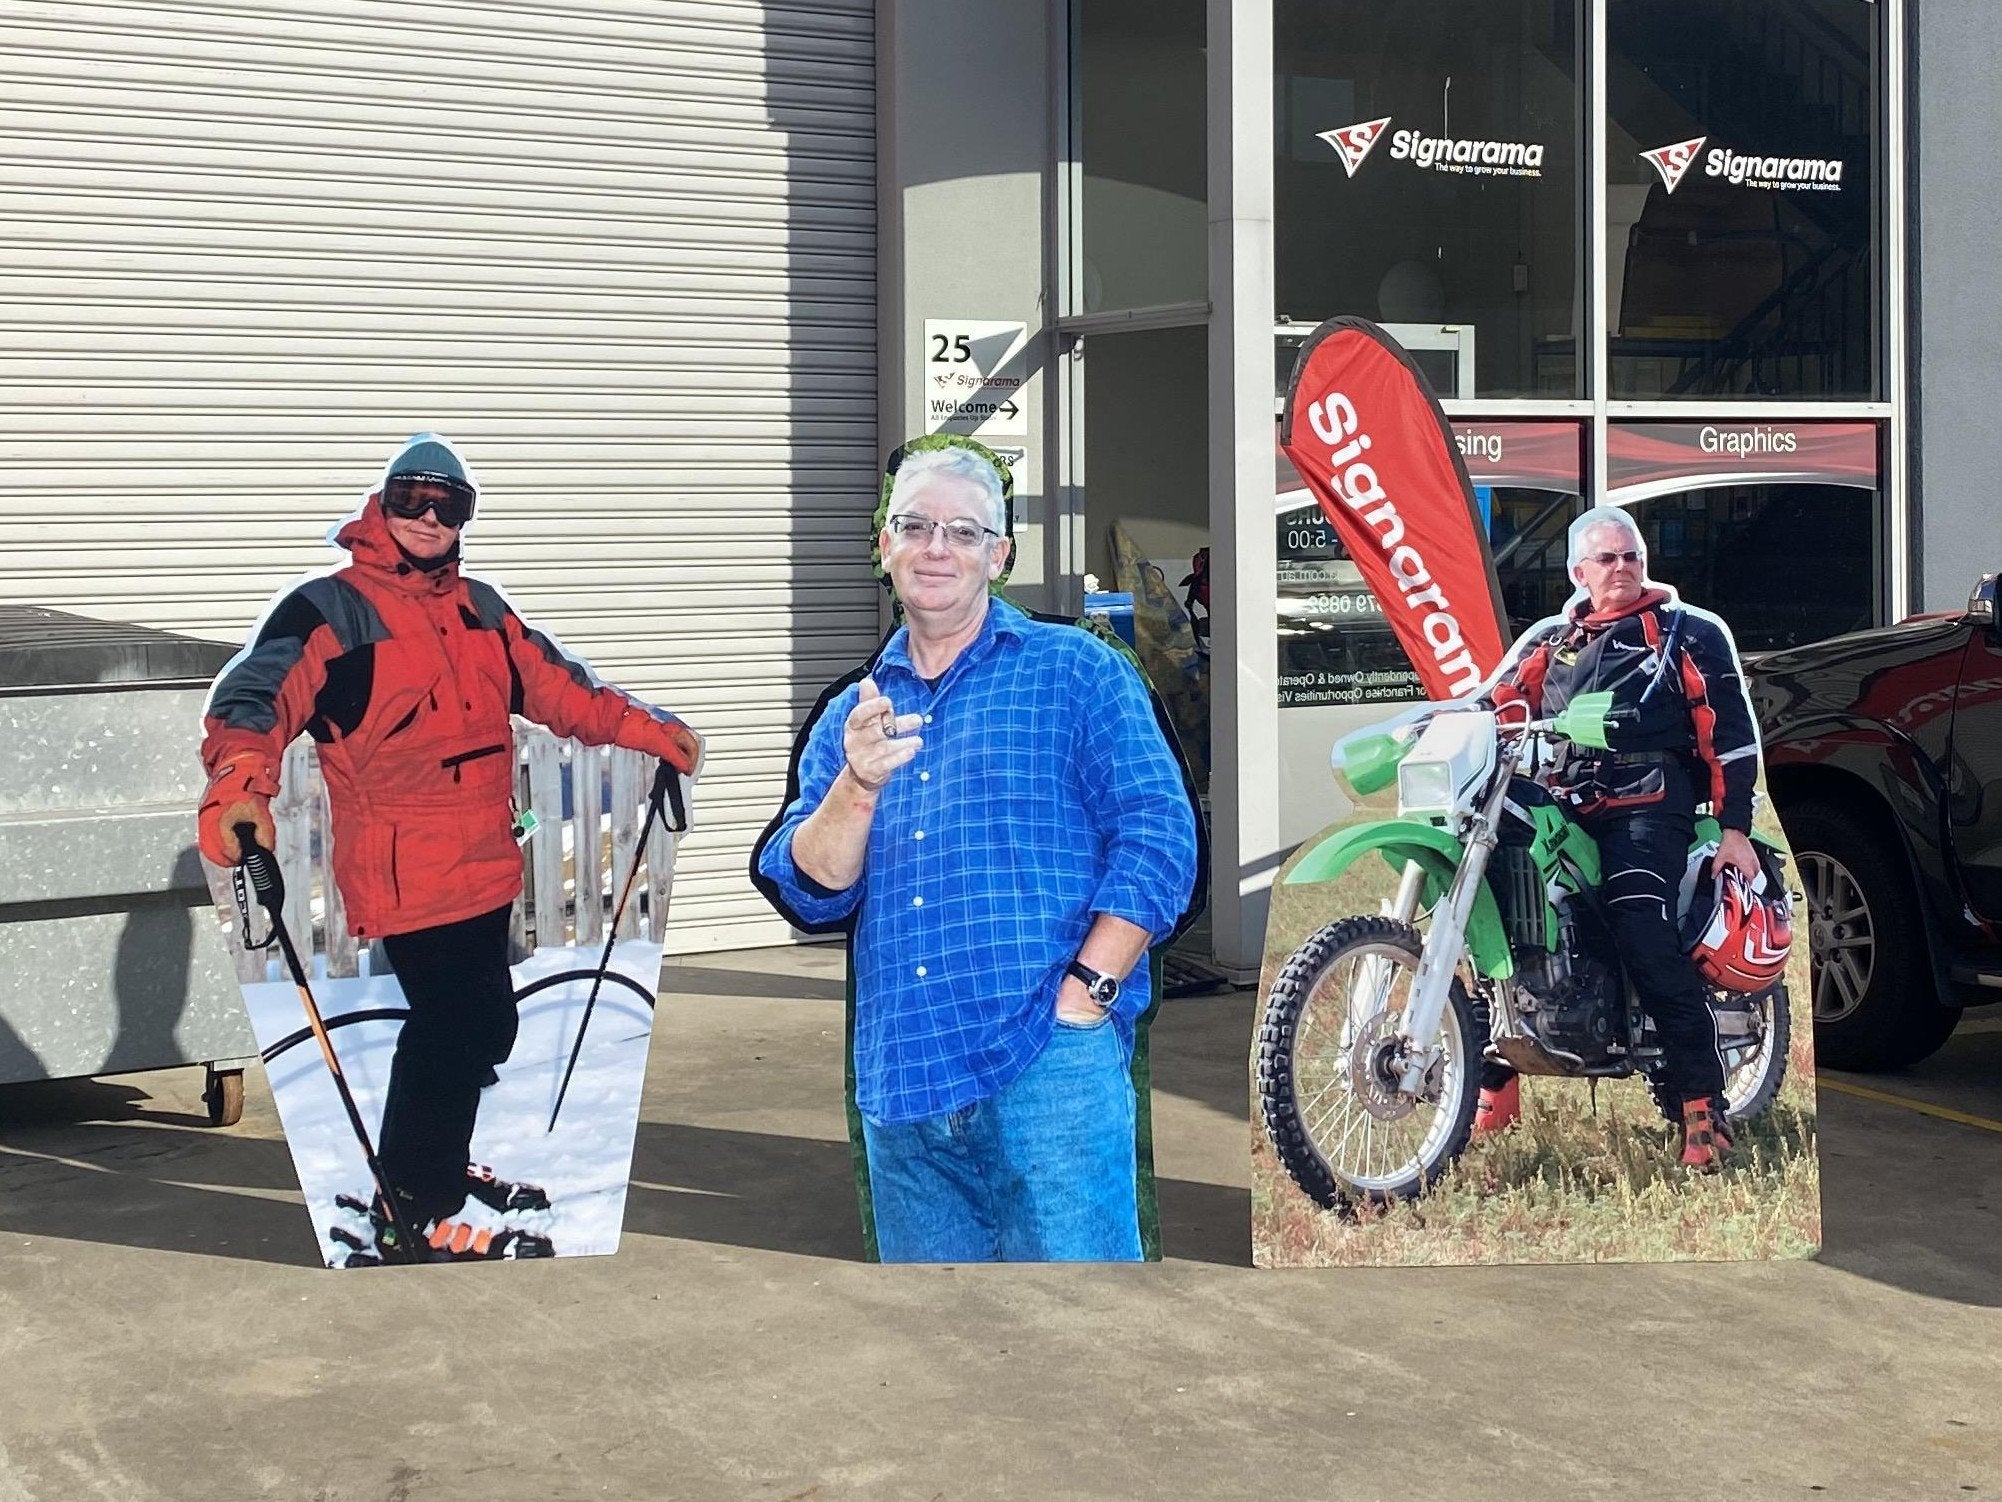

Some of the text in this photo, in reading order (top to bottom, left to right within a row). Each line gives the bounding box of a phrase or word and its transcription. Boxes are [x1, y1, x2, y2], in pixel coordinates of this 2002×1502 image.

[1390, 130, 1544, 167] Signarama
[1435, 162, 1542, 177] The way to grow your business.
[1705, 149, 1843, 184] Signarama
[1745, 179, 1757, 187] The
[1759, 180, 1771, 190] way
[1780, 182, 1796, 190] grow
[1796, 182, 1811, 191] your
[931, 334, 971, 363] 25
[956, 375, 1021, 388] Signarama
[931, 399, 997, 413] Welcome
[1455, 428, 1502, 462] sing
[1699, 426, 1797, 458] Graphics
